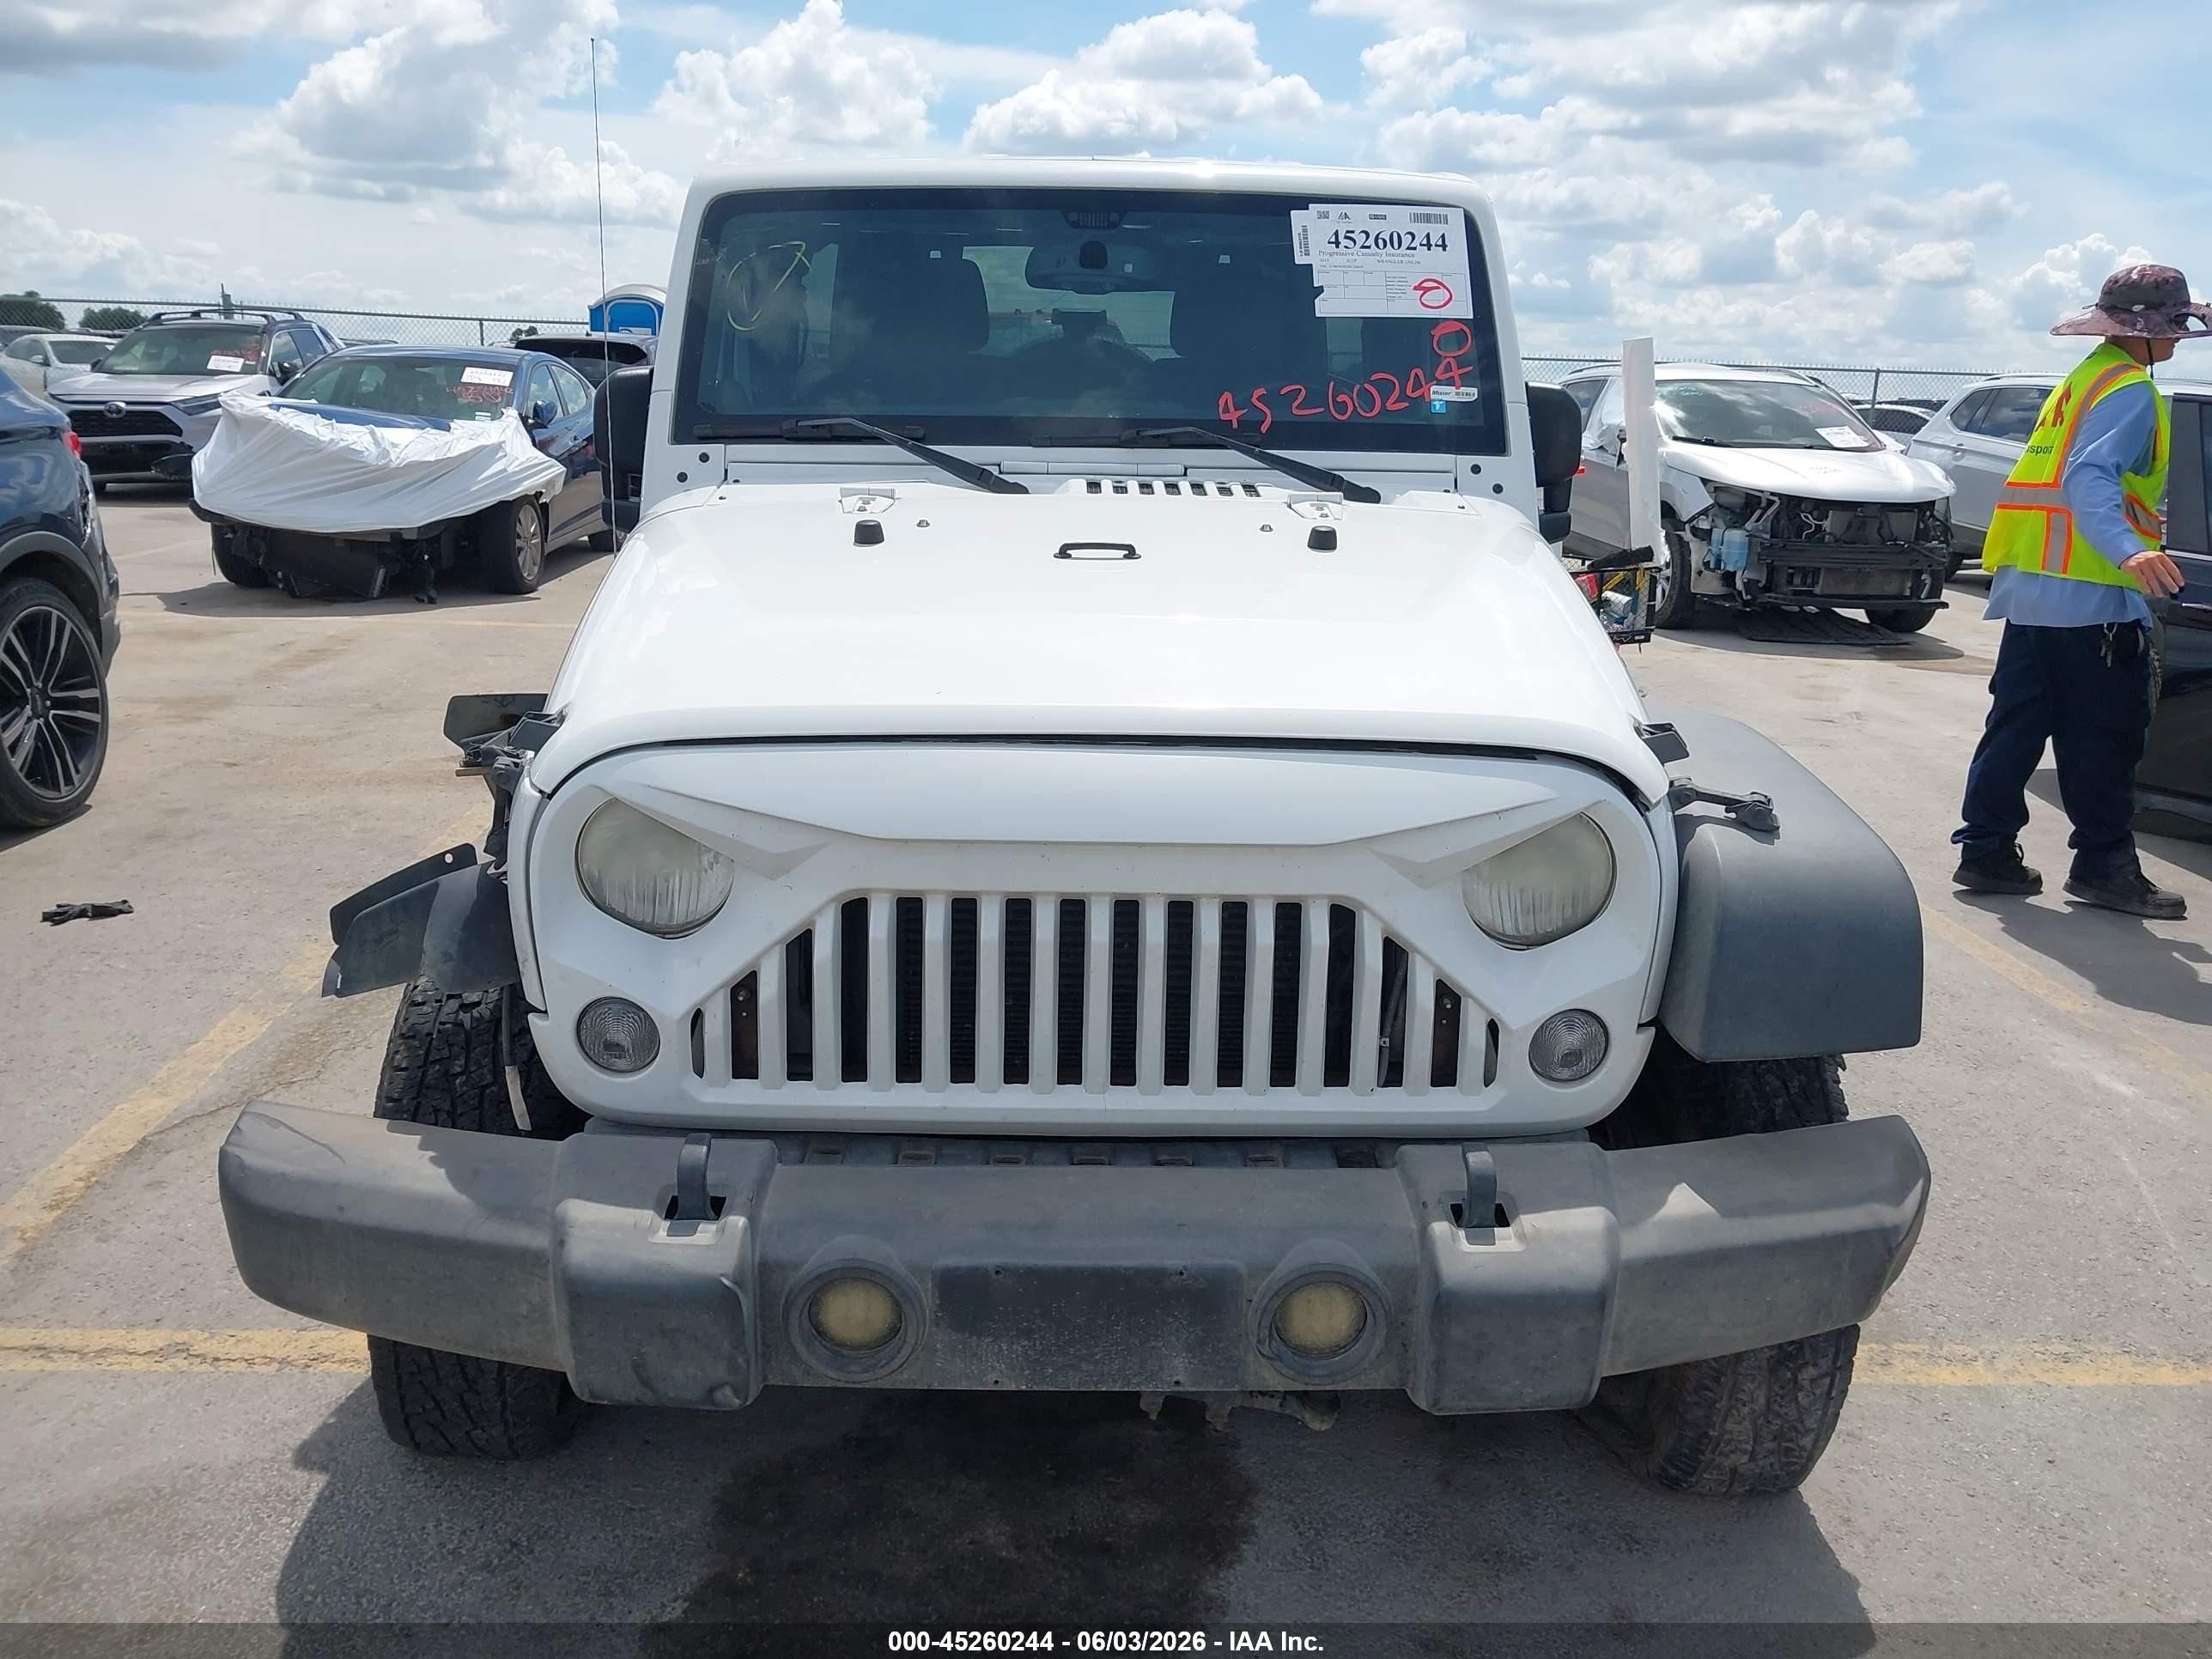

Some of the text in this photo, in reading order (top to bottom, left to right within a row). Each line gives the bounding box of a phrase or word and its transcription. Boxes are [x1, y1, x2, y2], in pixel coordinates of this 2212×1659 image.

[1327, 228, 1449, 252] 45260244
[1356, 250, 1383, 258] Casualty
[1218, 356, 1474, 433] 45260244
